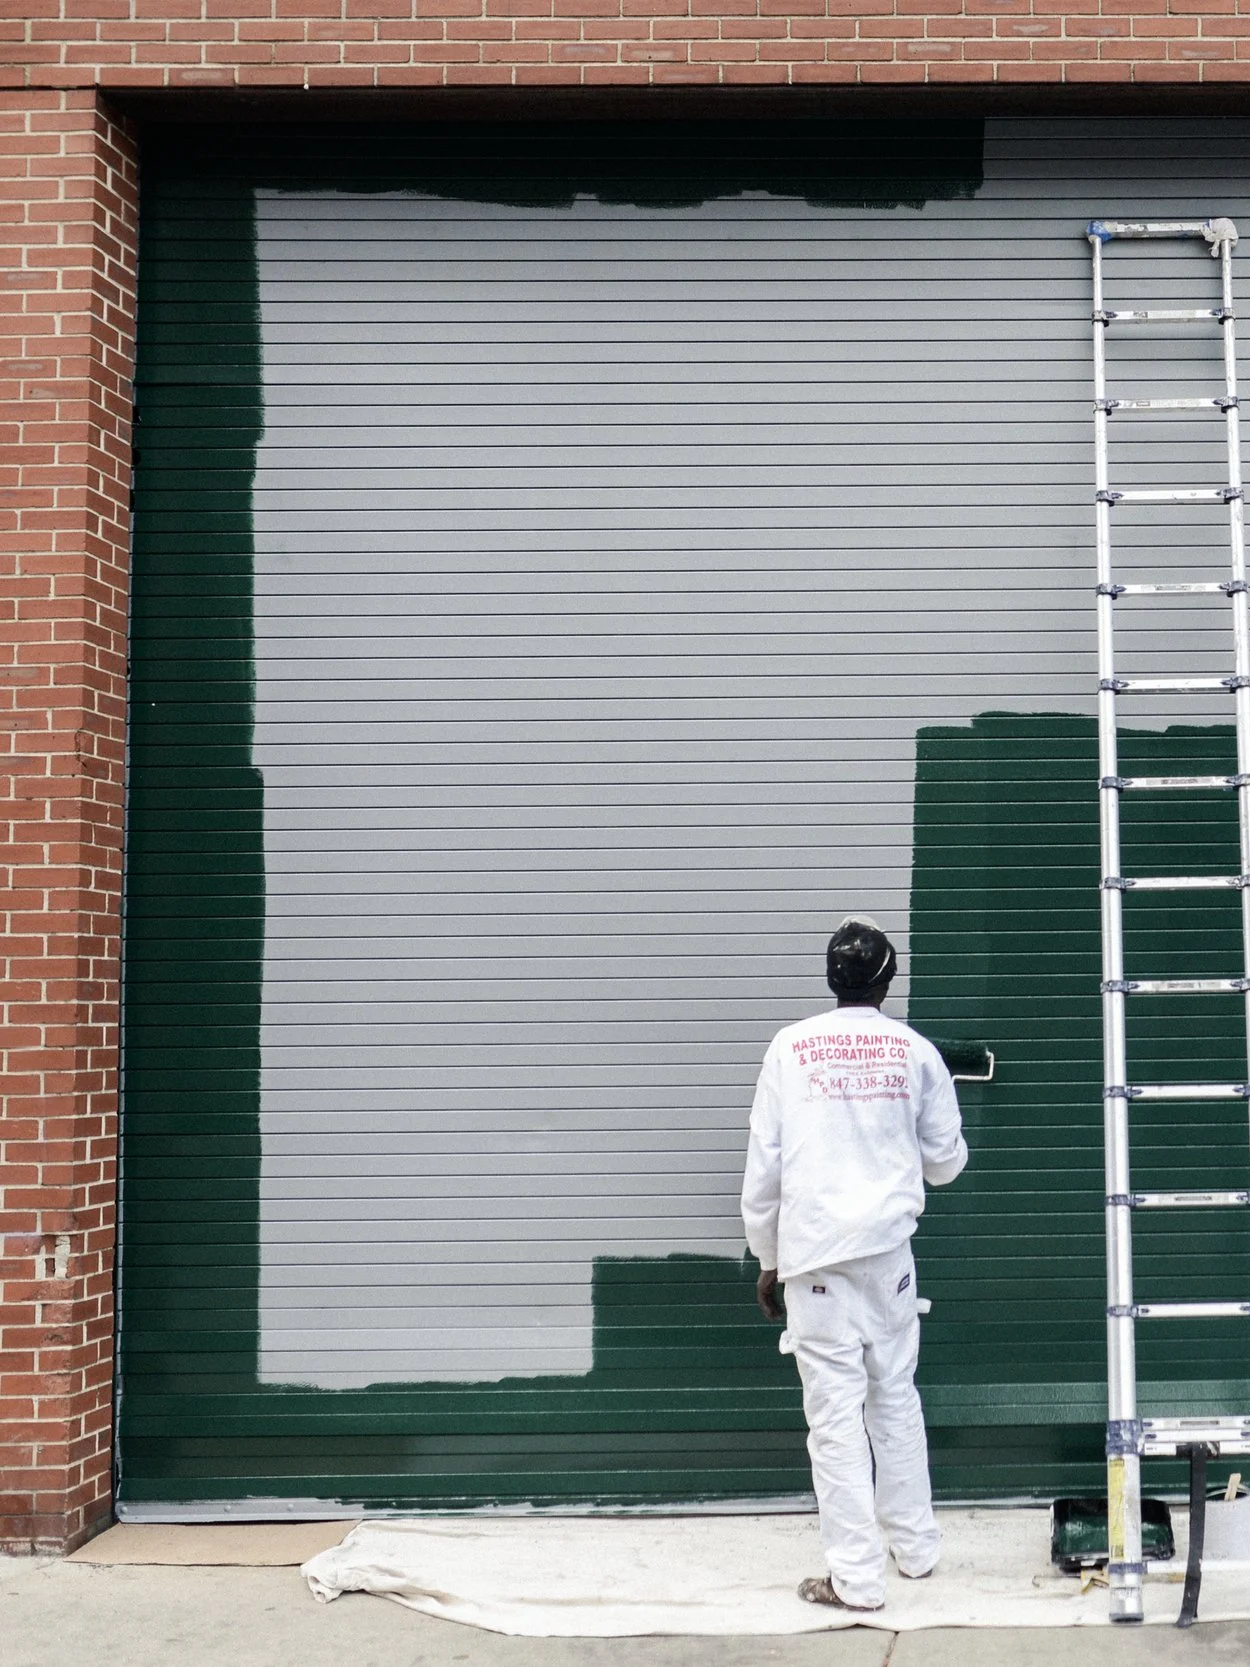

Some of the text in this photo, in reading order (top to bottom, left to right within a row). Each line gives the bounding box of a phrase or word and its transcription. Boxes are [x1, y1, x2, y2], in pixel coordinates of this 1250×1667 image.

[792, 1034, 911, 1053] HASTINGS PAINTING
[799, 1054, 807, 1066] &
[810, 1047, 886, 1062] DECORATING
